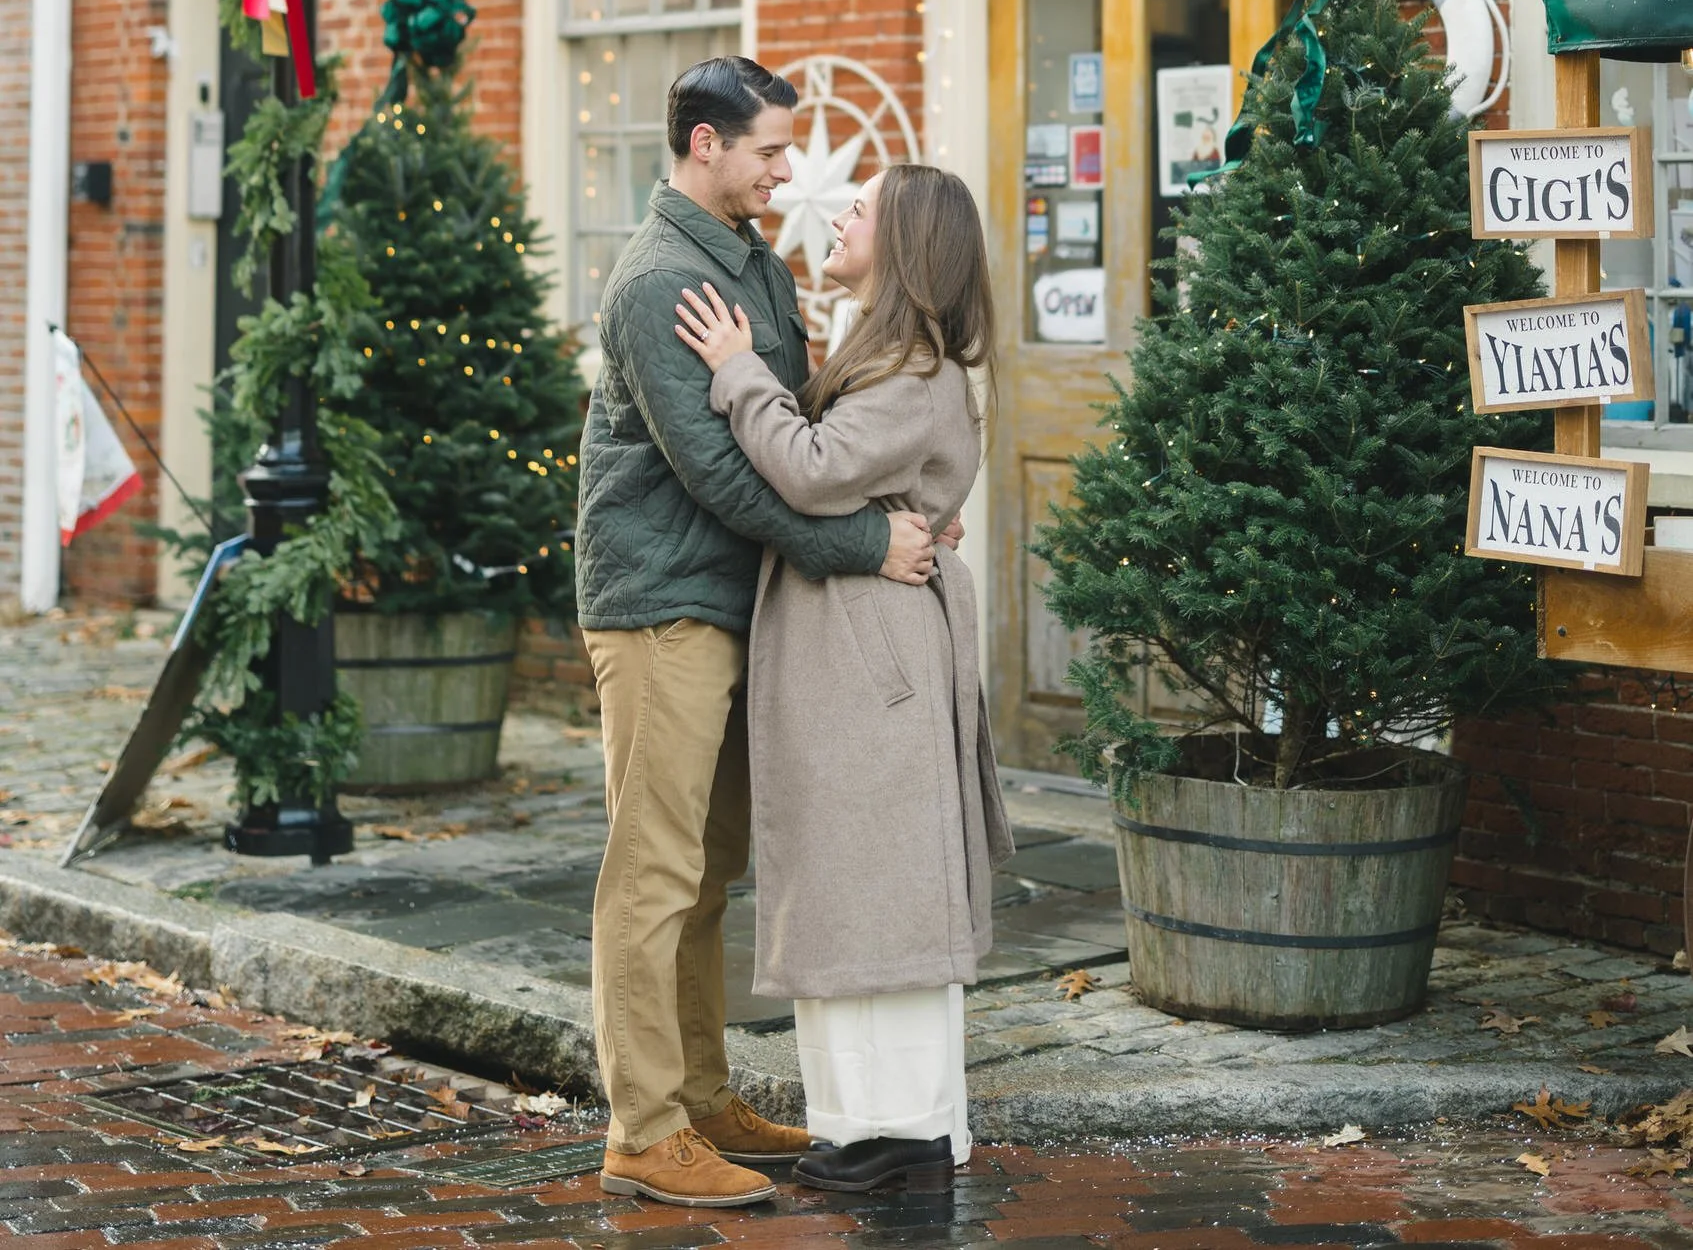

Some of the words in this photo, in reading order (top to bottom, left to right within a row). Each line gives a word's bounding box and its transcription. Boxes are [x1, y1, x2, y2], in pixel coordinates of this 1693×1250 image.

[1510, 145, 1579, 161] WELCOME
[1585, 144, 1604, 159] TO
[1489, 157, 1630, 222] GIGI'S
[1506, 313, 1577, 333] WELCOME
[1580, 310, 1600, 326] TO
[1485, 319, 1630, 395] YIAYIA'S
[1512, 468, 1579, 489] WELCOME
[1583, 475, 1602, 491] TO
[1486, 478, 1621, 556] NANA'S
